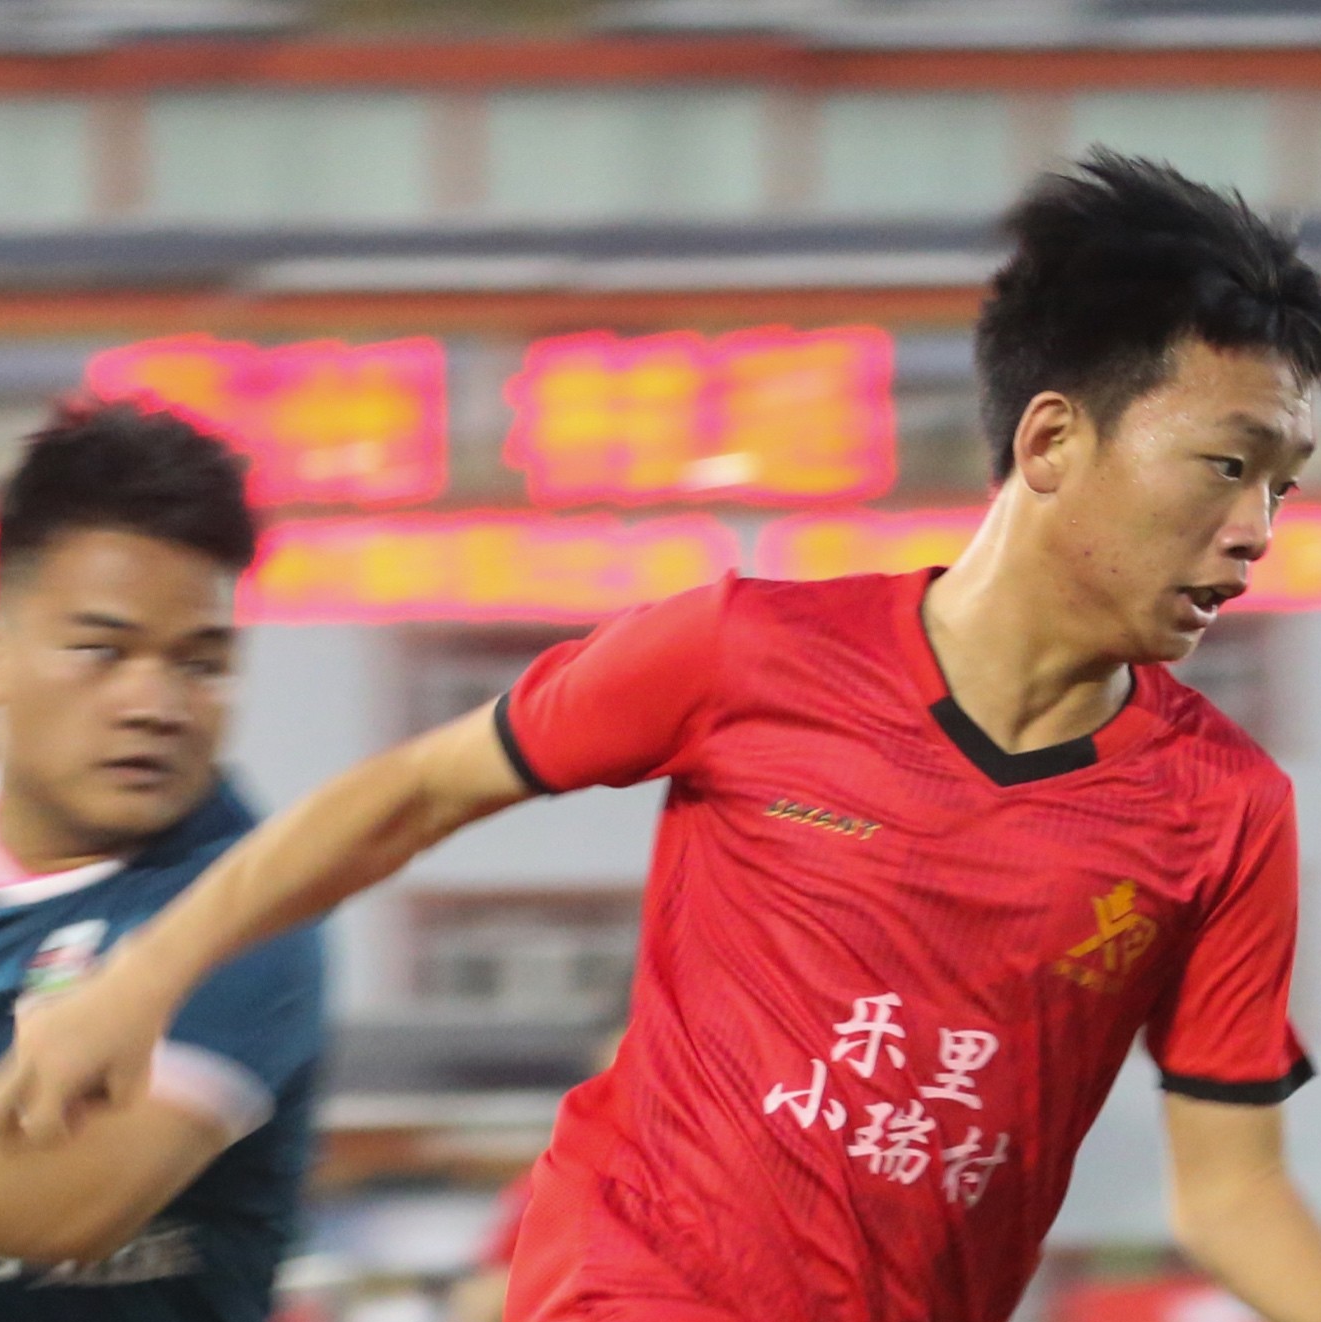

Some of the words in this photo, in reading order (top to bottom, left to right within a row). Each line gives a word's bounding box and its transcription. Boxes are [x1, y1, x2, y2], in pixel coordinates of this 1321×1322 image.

[832, 992, 999, 1110] 乐里
[764, 1059, 1009, 1208] 小瑞村
